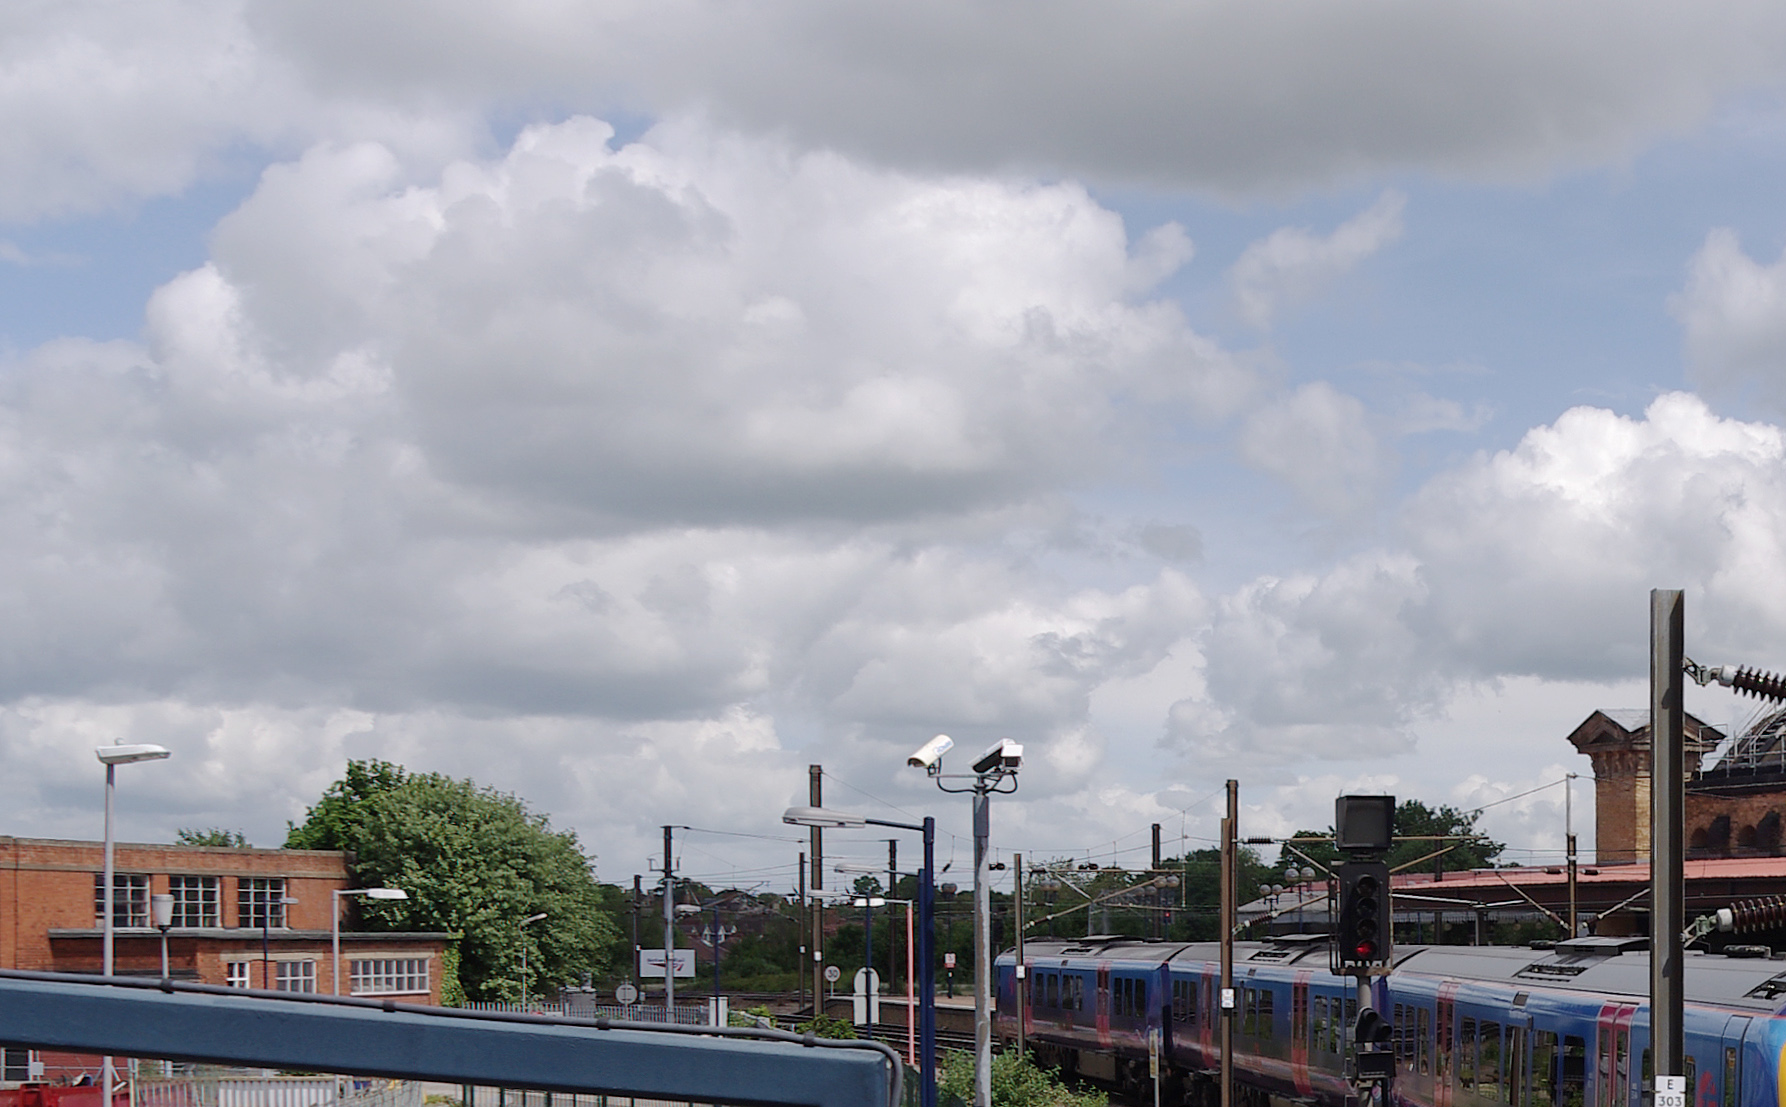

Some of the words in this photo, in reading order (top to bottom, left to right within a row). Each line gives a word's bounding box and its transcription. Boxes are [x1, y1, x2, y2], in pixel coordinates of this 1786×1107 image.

[828, 969, 838, 978] 30
[1667, 1079, 1674, 1090] E
[1658, 1096, 1682, 1107] 303
